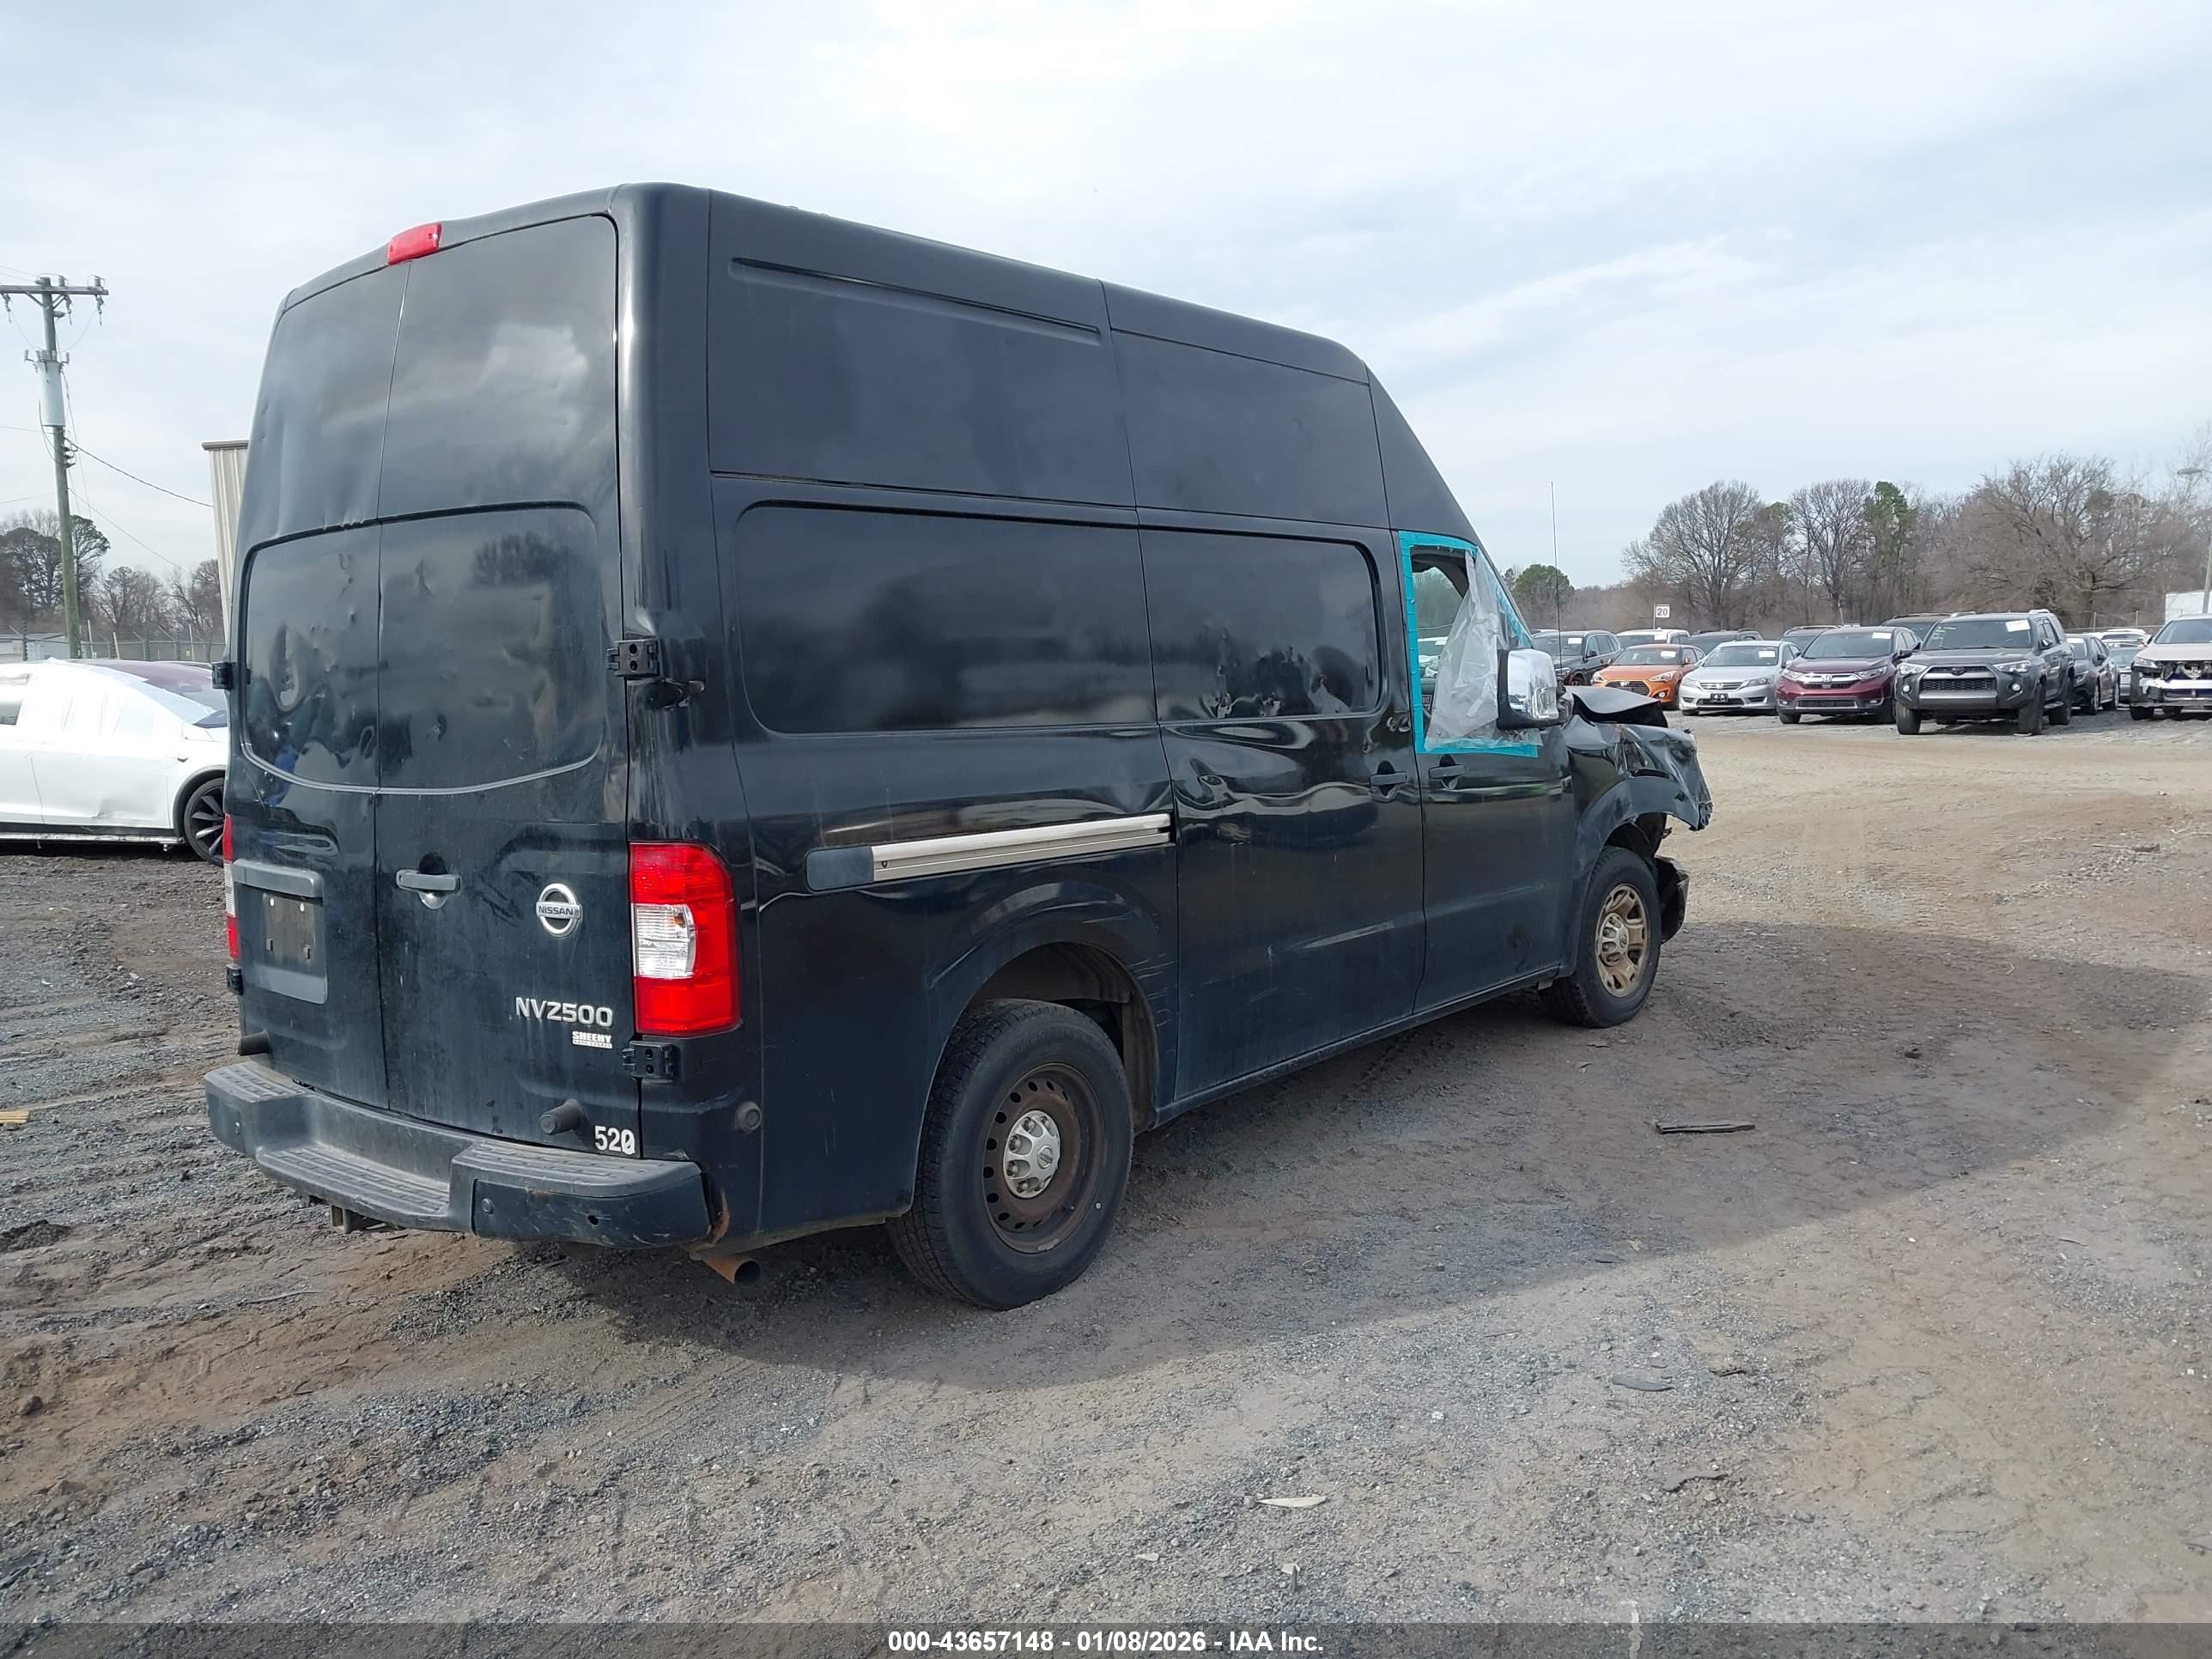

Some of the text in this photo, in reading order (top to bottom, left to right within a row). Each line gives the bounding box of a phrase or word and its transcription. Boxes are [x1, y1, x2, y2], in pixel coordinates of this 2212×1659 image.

[1657, 607, 1668, 617] 20
[538, 905, 574, 915] NISSAN
[515, 997, 613, 1027] NV2500
[594, 1125, 635, 1155] 520
